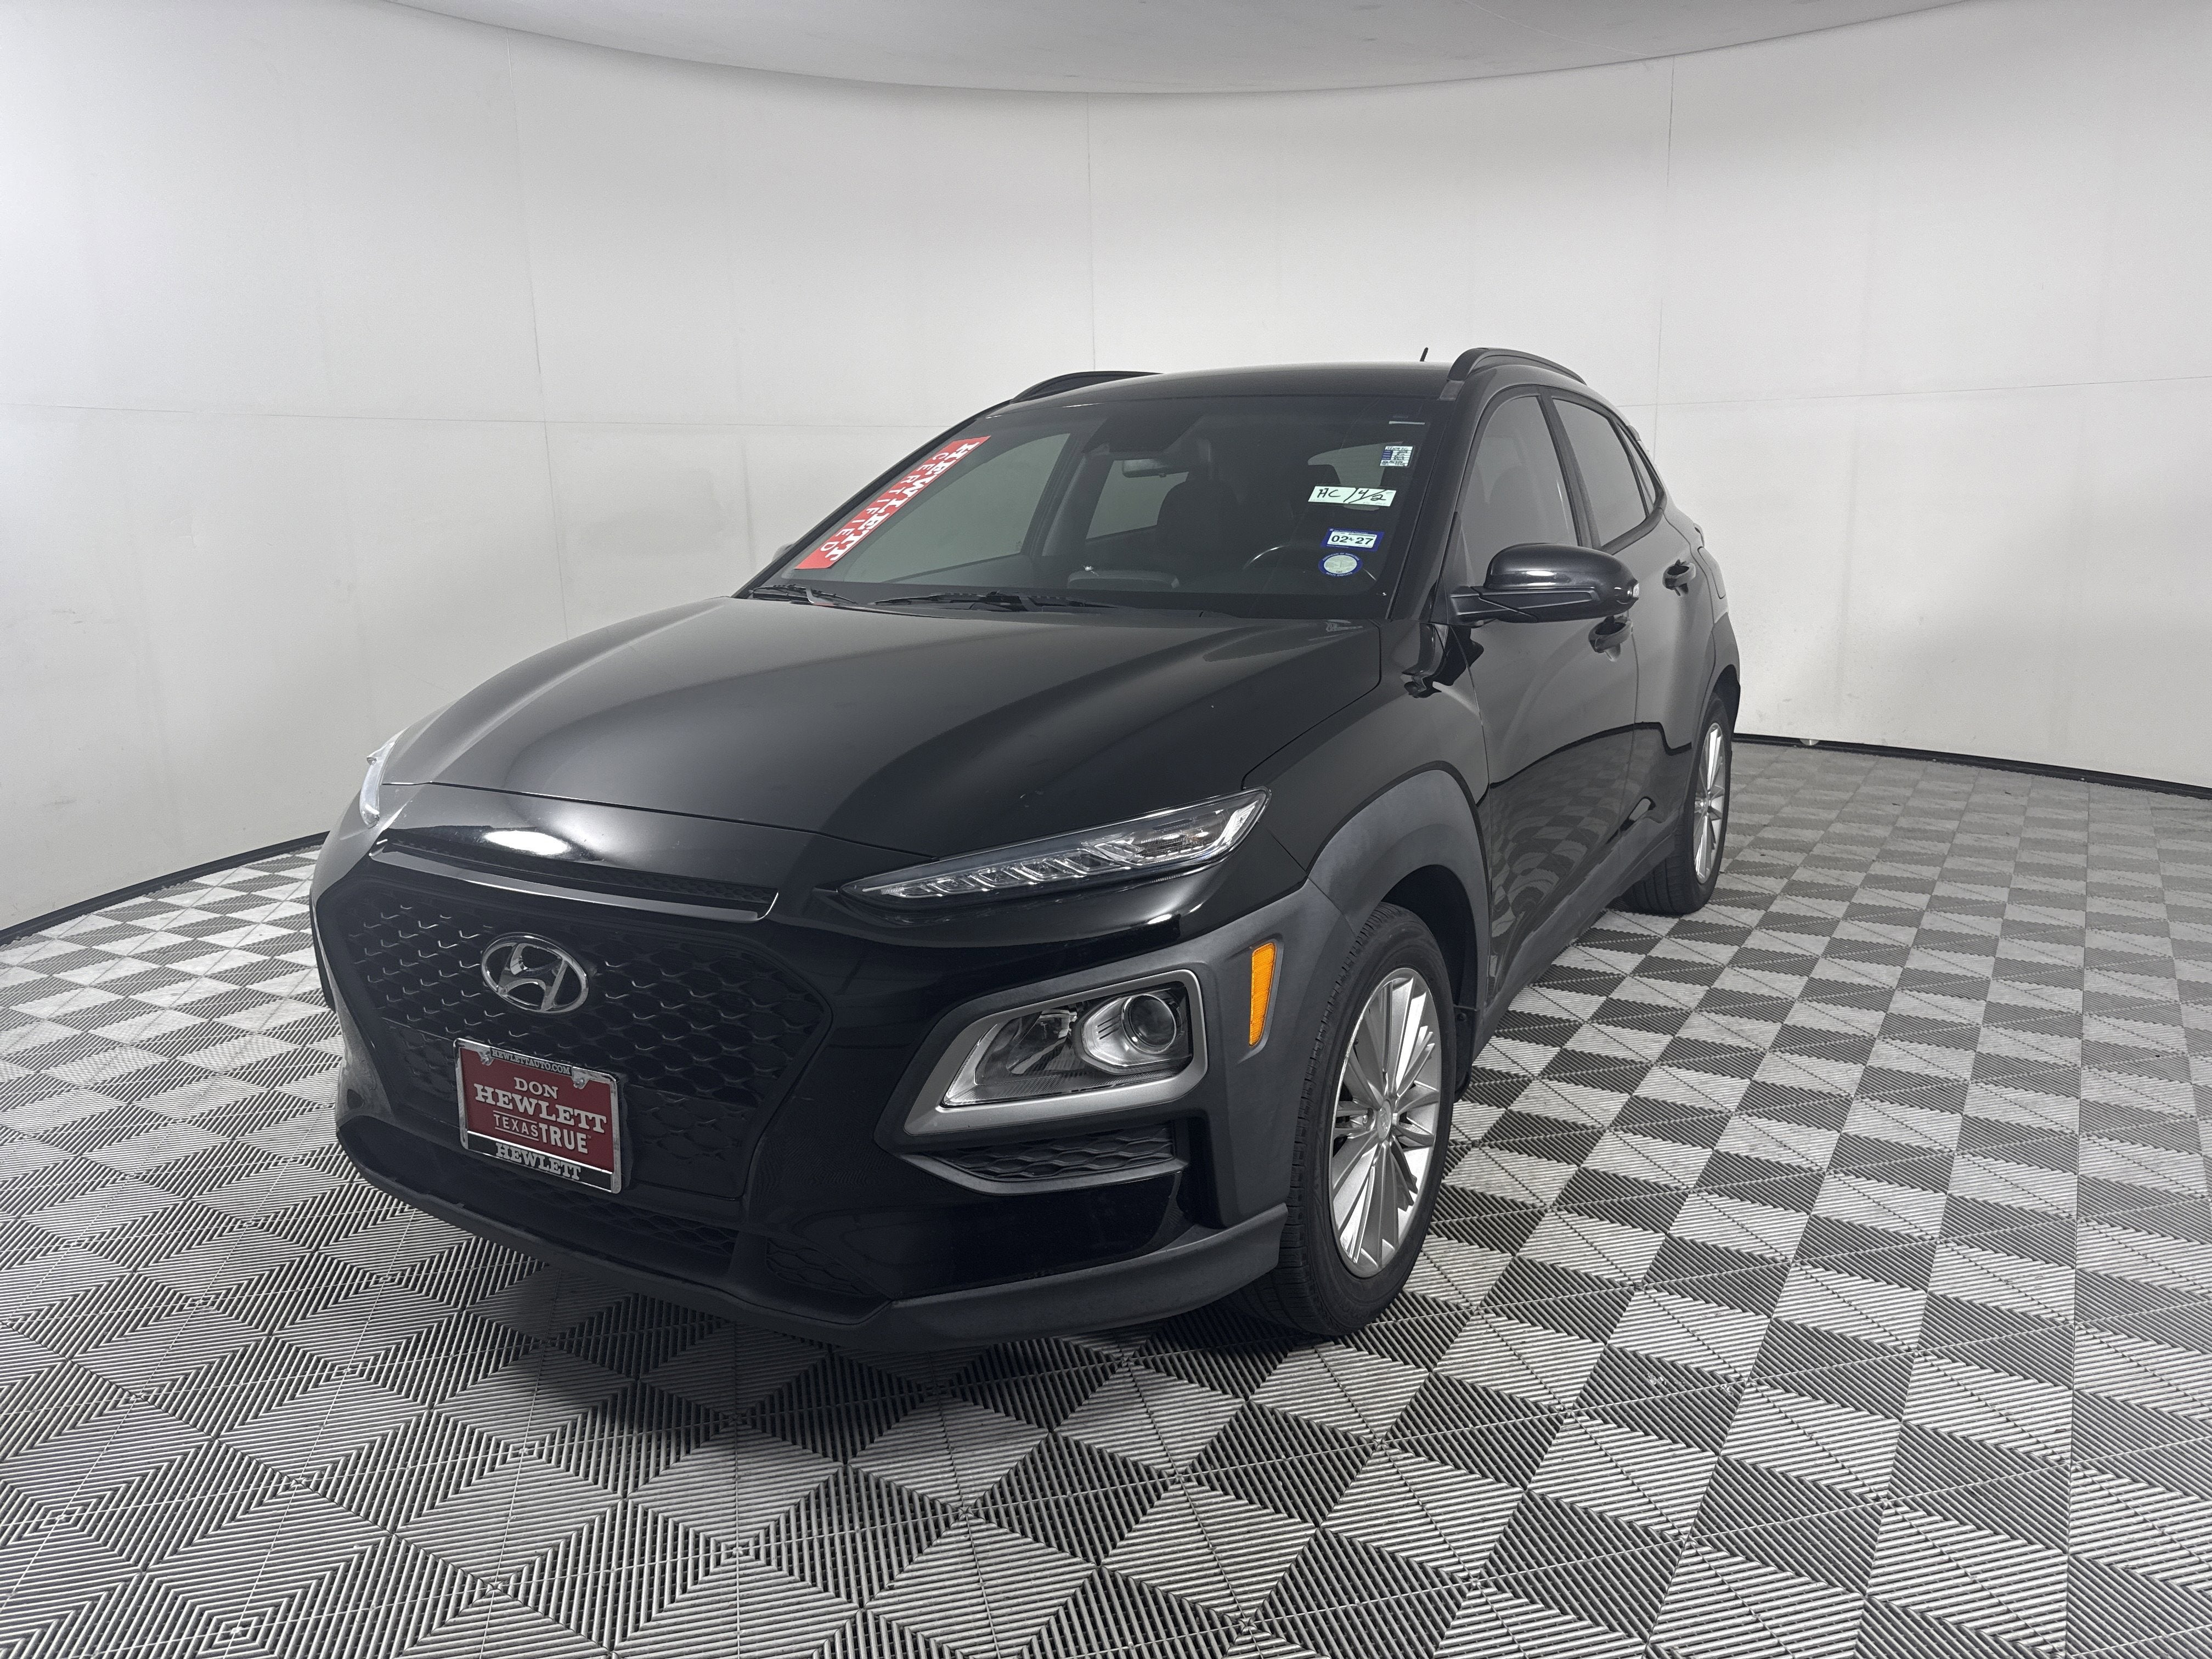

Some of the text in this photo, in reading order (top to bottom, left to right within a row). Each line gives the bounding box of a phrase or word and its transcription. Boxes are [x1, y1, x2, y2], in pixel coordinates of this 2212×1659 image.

[821, 453, 947, 551] CERTIFIED
[825, 442, 980, 561] HEWLETT
[492, 1049, 571, 1074] HEWLETTAUTO.COM
[474, 1084, 606, 1133] HEWLETT
[514, 1077, 558, 1099] DON
[495, 1143, 581, 1180] HEWLETT
